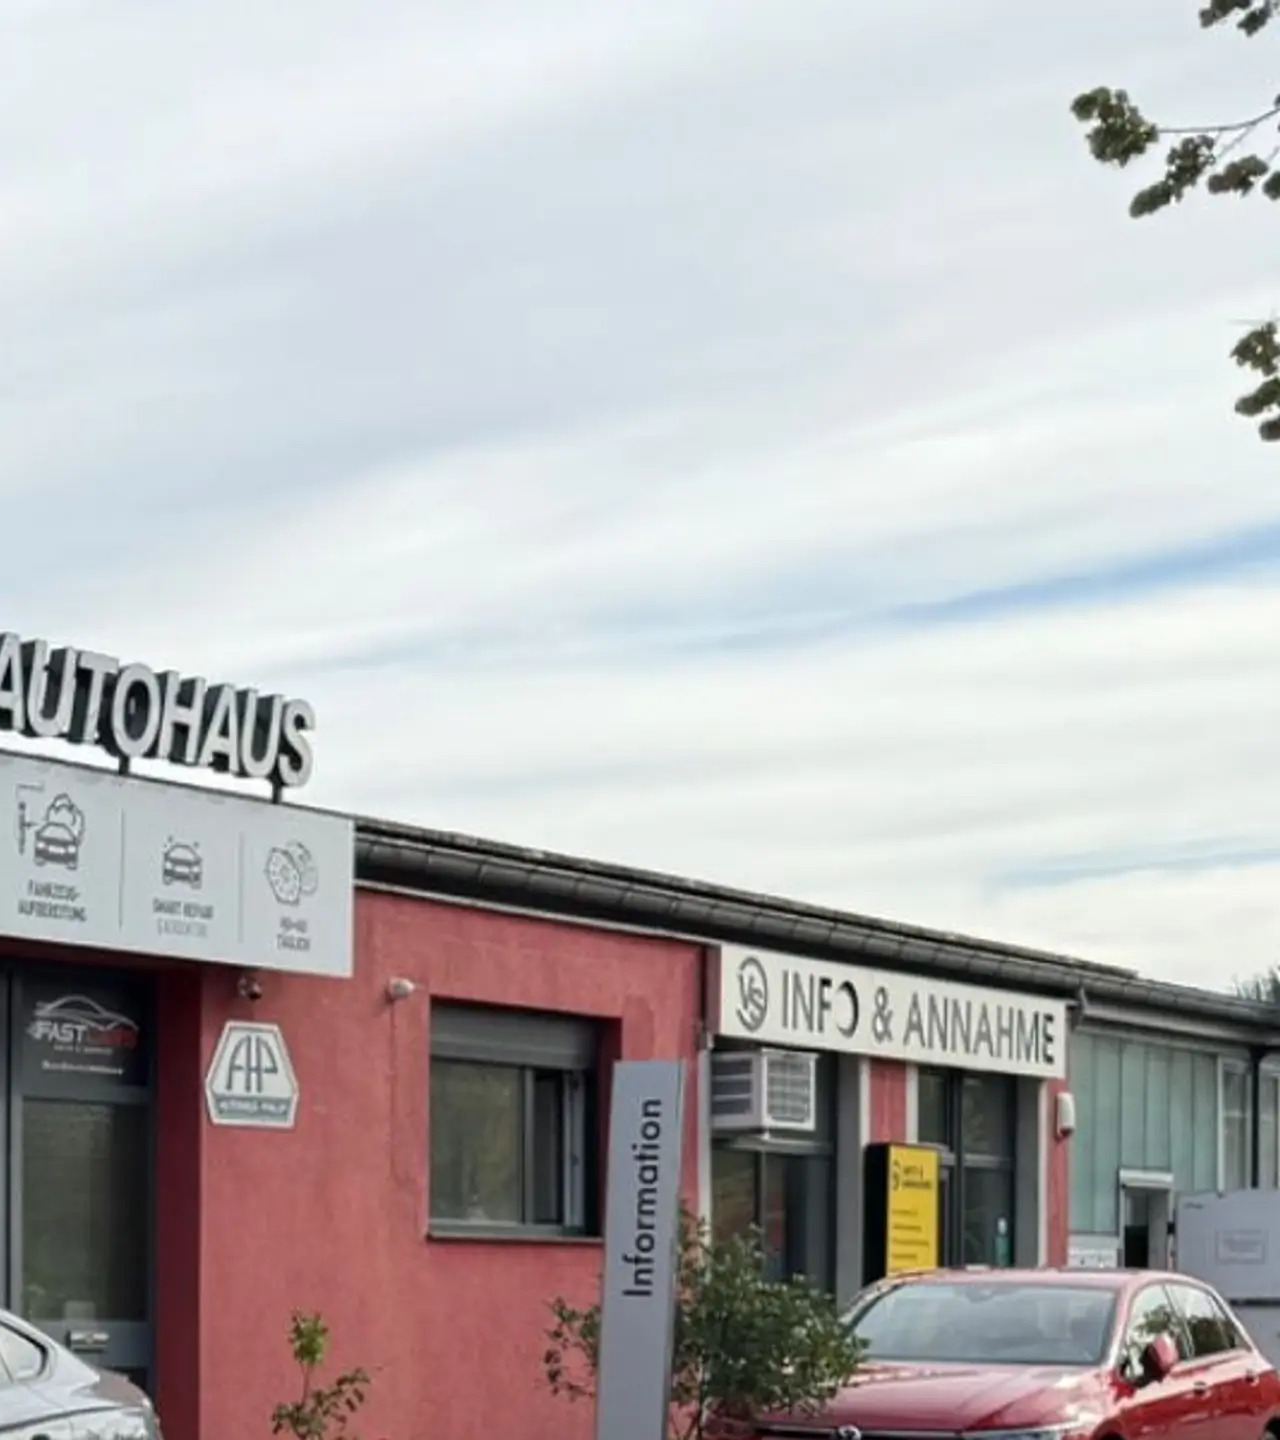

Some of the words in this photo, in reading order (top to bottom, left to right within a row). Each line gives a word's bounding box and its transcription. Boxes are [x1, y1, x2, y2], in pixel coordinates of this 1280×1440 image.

[781, 968, 860, 1039] INFO
[872, 985, 894, 1045] &
[903, 991, 1055, 1065] ANNAHME
[622, 1098, 662, 1297] Information
